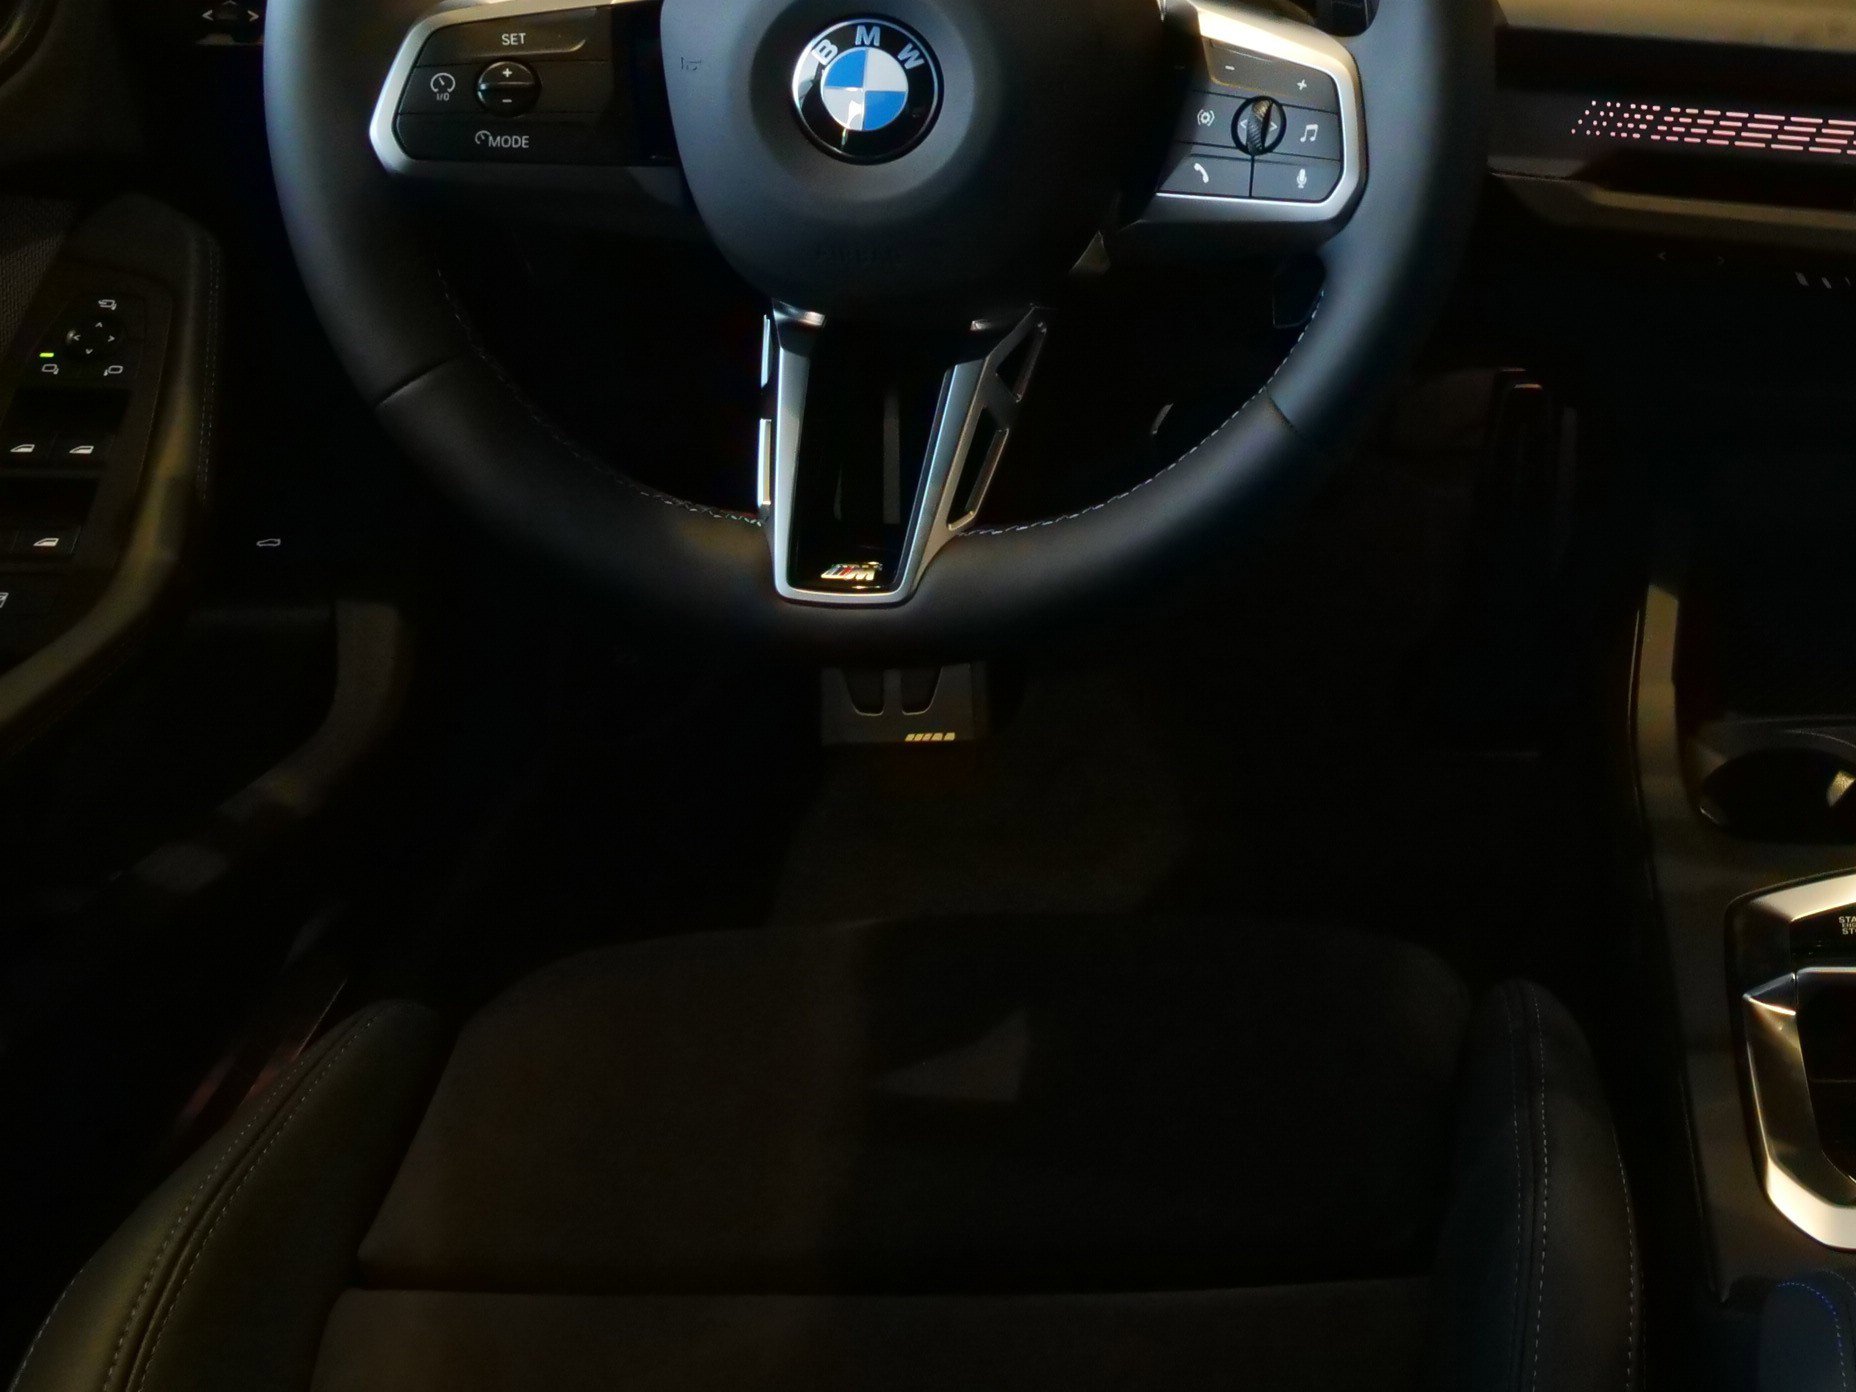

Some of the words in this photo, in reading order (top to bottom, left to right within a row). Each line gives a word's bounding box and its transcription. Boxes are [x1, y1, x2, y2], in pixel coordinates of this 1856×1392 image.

[501, 32, 527, 46] SET
[810, 24, 926, 70] BMW
[487, 134, 530, 149] MODE
